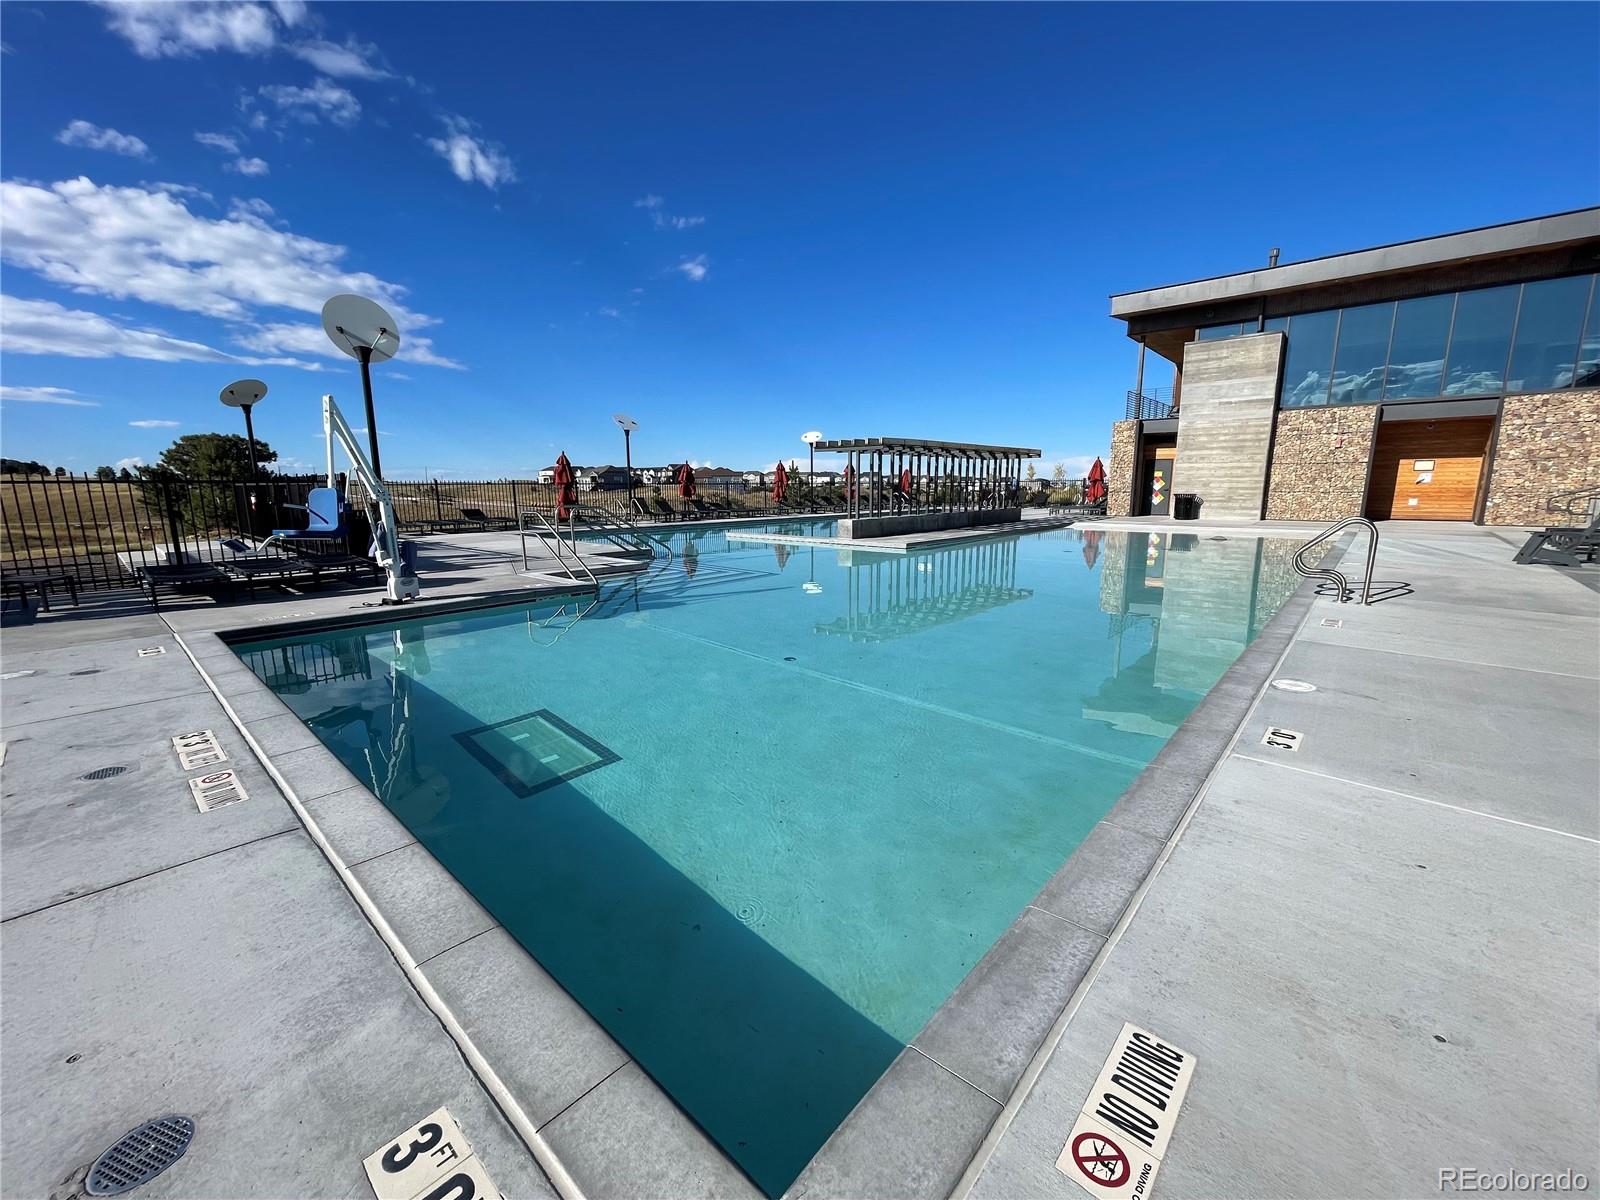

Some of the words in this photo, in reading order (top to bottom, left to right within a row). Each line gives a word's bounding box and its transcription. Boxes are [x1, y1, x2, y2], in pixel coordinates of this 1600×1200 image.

[1111, 1032, 1184, 1112] DIVING
[1095, 1092, 1159, 1148] NO
[381, 1122, 443, 1174] 3
[430, 1141, 458, 1168] FT
[1135, 1163, 1152, 1194] DIVING
